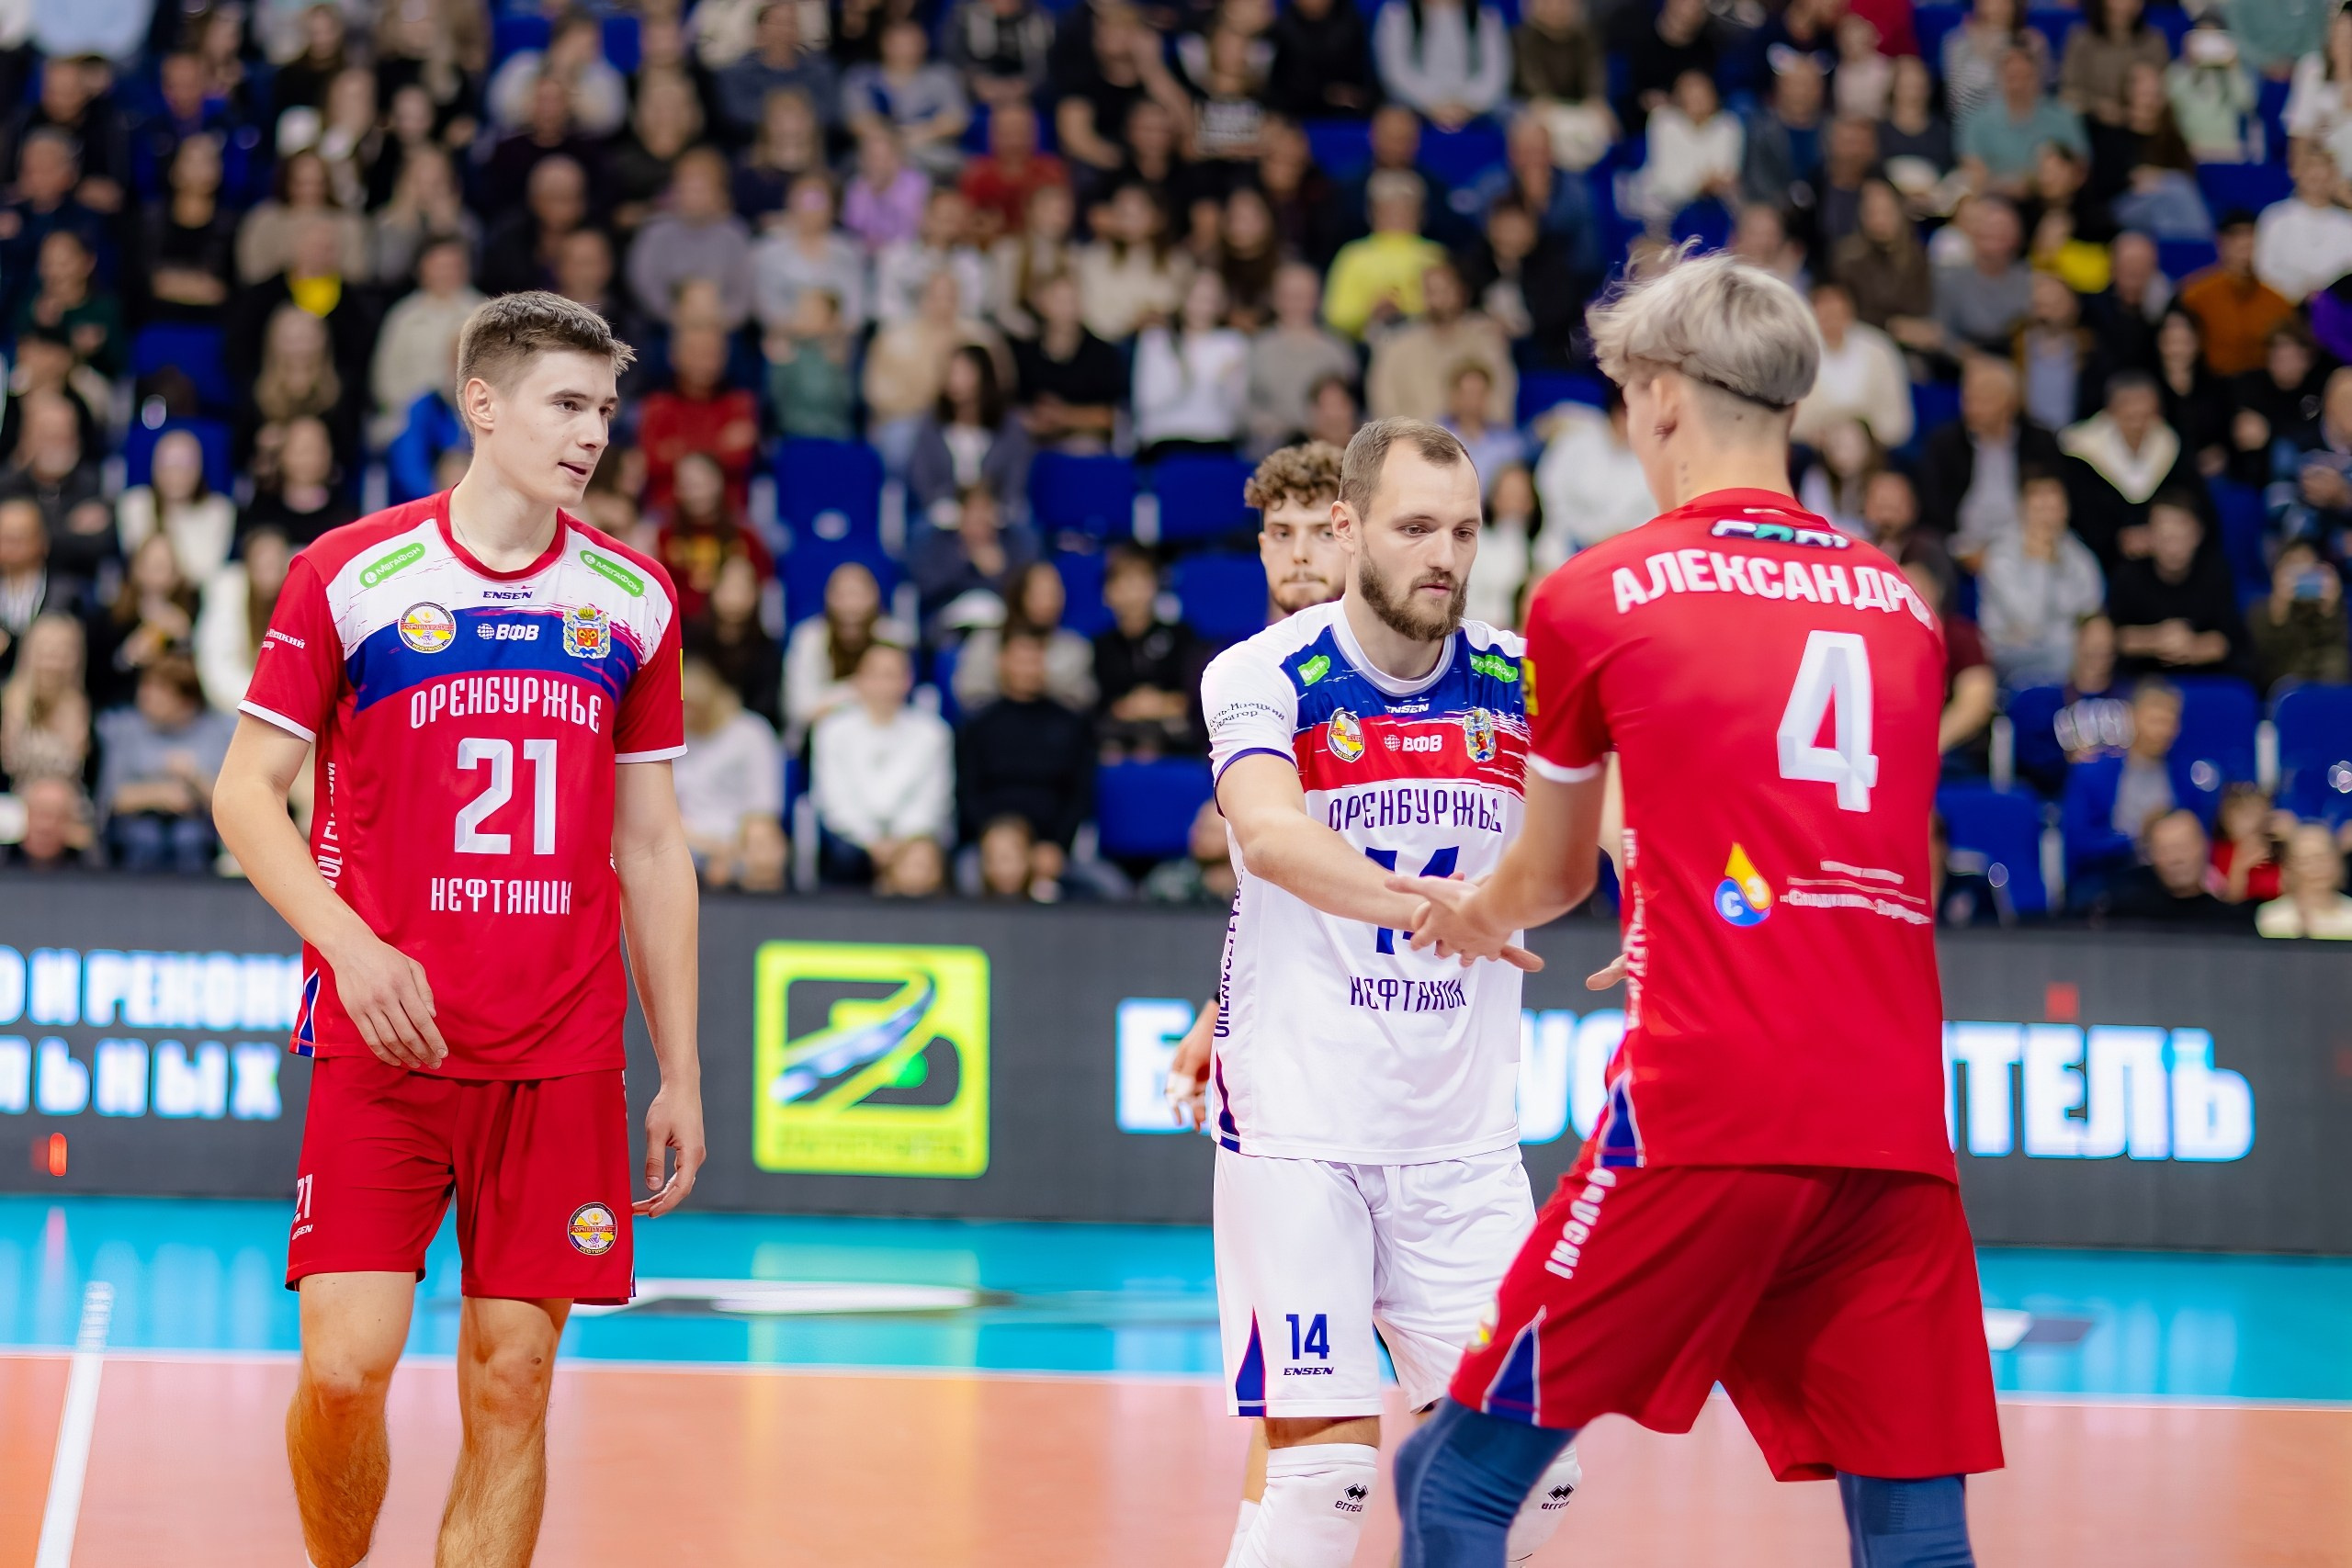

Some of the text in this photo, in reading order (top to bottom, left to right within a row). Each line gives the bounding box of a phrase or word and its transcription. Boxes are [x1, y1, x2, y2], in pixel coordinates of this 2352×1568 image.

[482, 591, 533, 600] ENSEN
[495, 624, 539, 641] ВФВ
[411, 676, 602, 734] ОРЕНБУРЖЬЕ
[1776, 629, 1879, 814] 4
[1402, 734, 1442, 752] ВФВ
[454, 738, 558, 855] 21
[1329, 788, 1503, 833] ОРЕНБУРЖЬЕ
[430, 877, 572, 915] НЕФТЯНИК
[1349, 975, 1467, 1012] НЕФТЯНИК
[1285, 1314, 1330, 1360] 14
[1283, 1366, 1334, 1376] ENSEN
